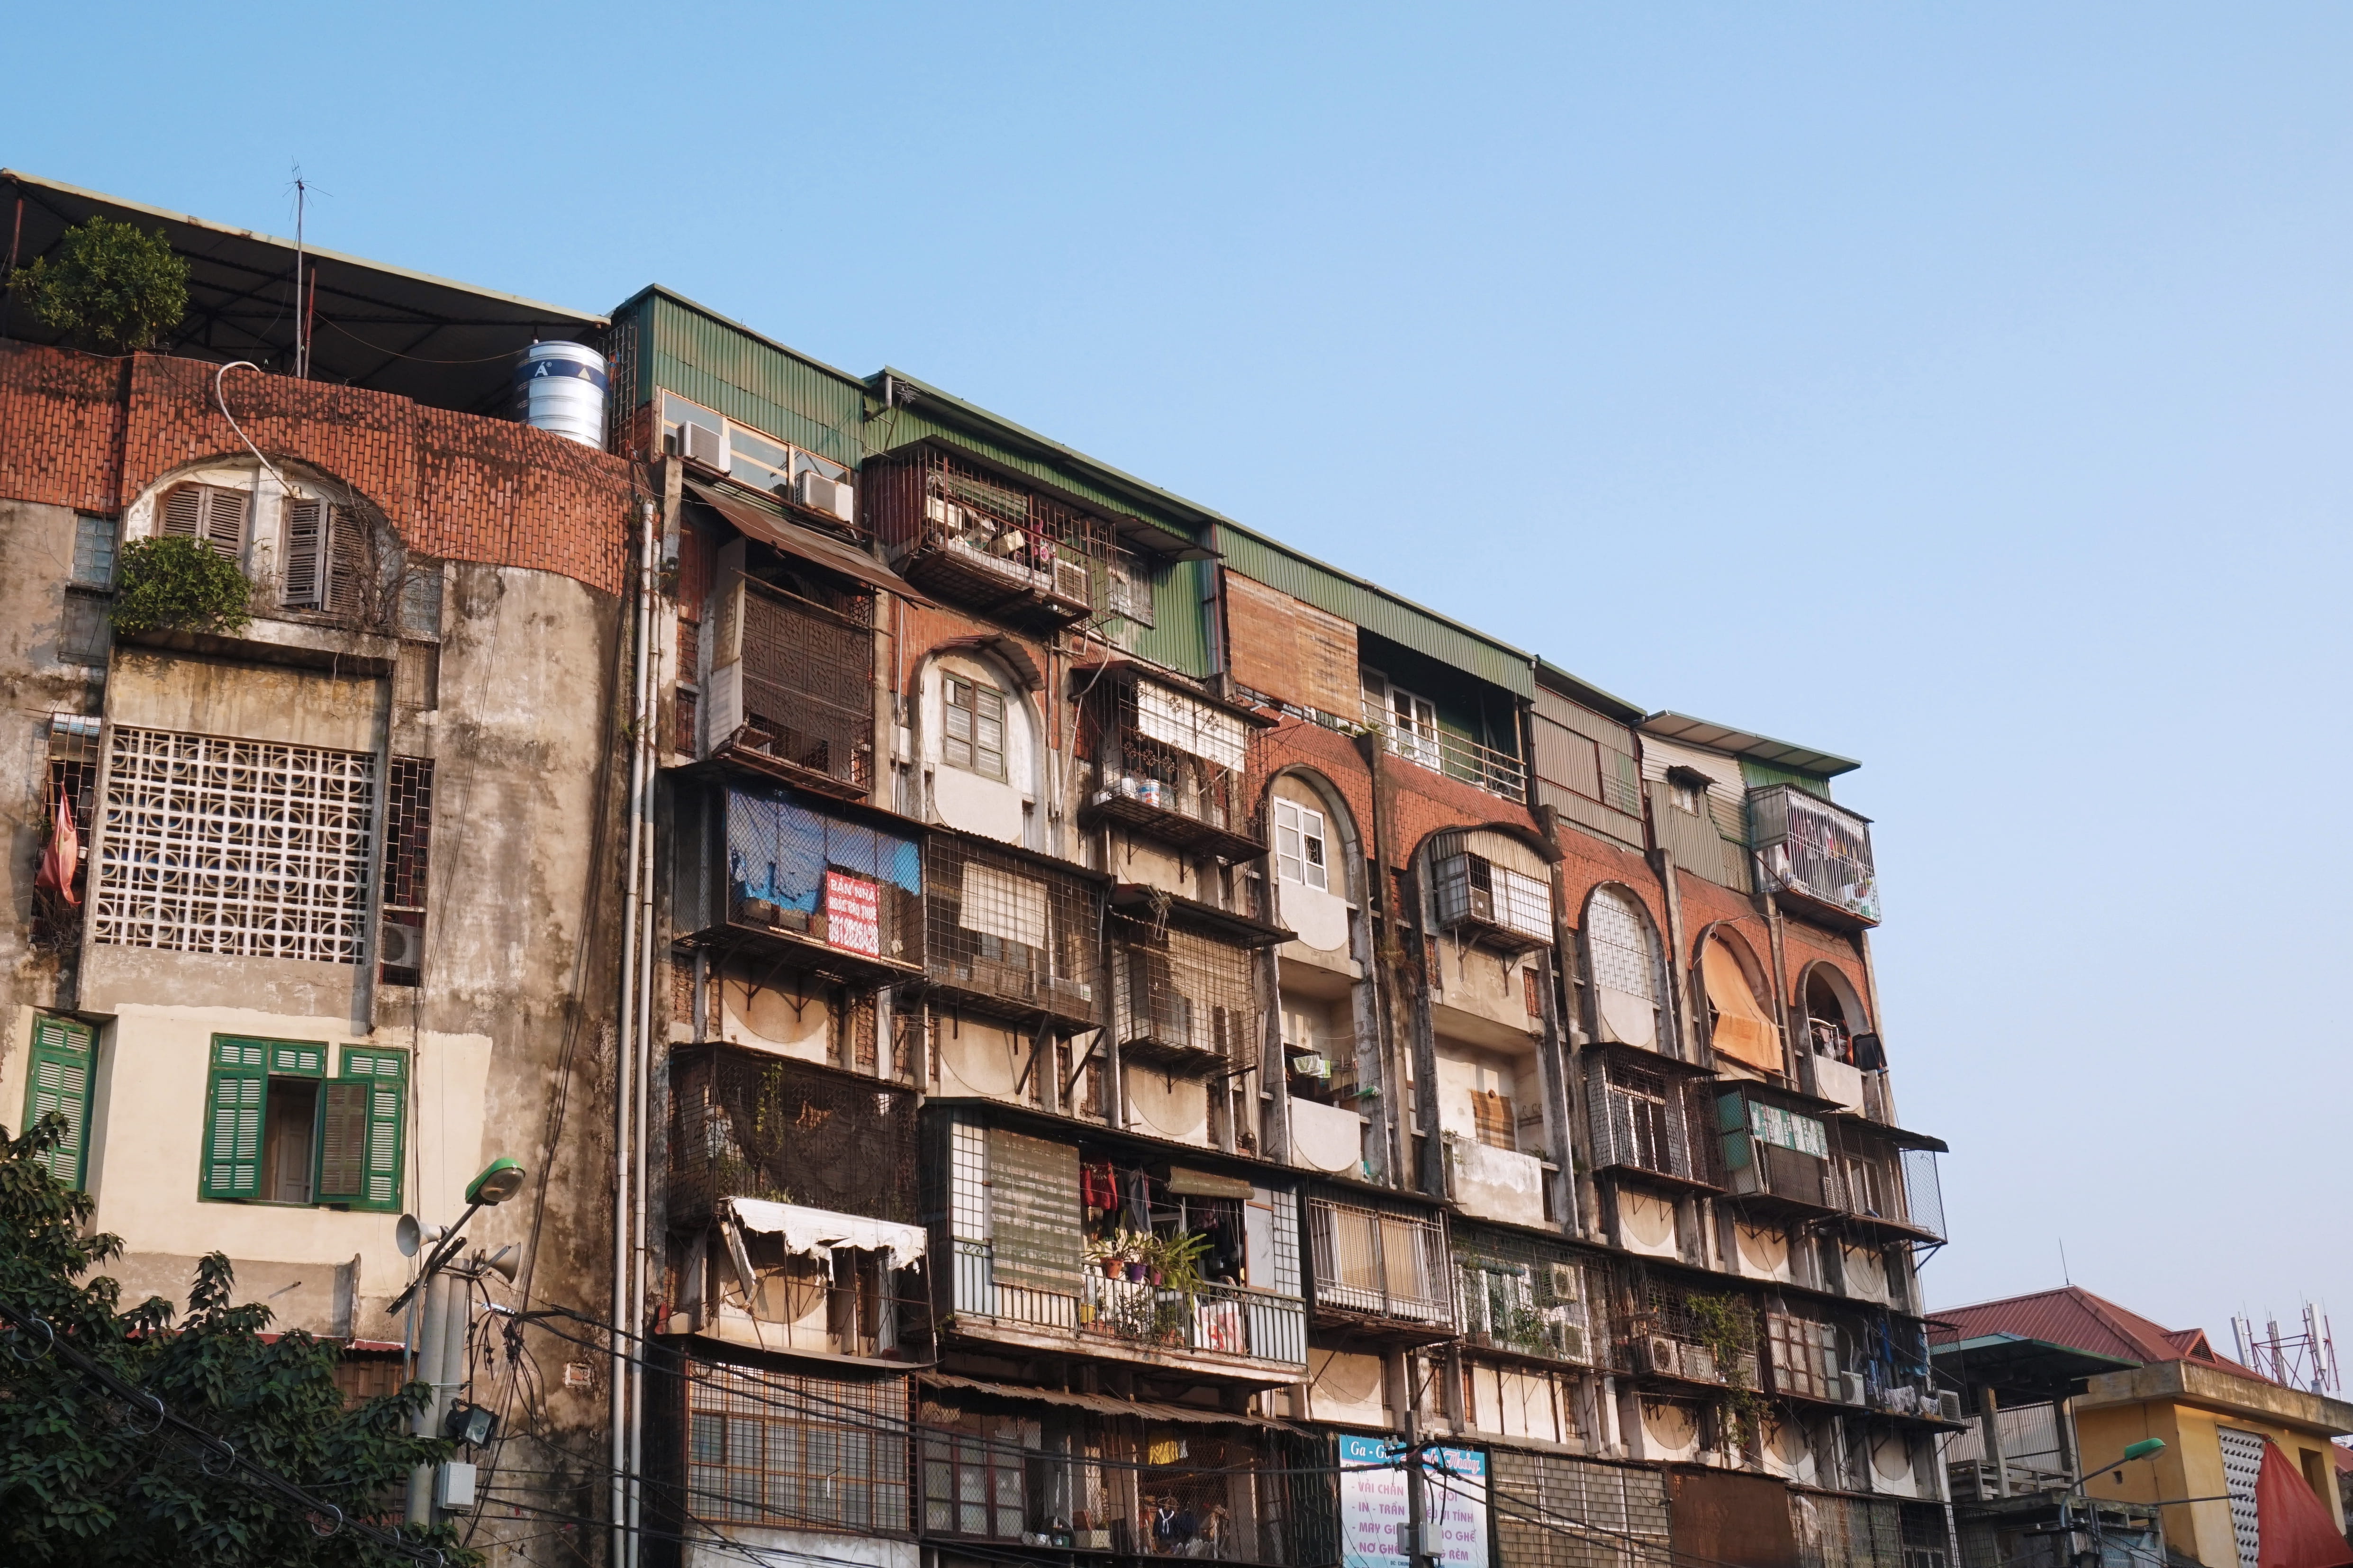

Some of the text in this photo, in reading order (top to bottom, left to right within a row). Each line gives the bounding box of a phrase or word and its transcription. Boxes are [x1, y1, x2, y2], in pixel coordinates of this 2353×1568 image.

[830, 878, 876, 902] BÁN NHÀ
[1350, 1441, 1366, 1457] Ga
[1358, 1478, 1374, 1493] VẢI
[1359, 1502, 1369, 1513] IN
[1379, 1501, 1405, 1516] TRẦN
[1452, 1509, 1473, 1523] TÍNH
[1359, 1522, 1380, 1533] MAY
[1359, 1541, 1376, 1553] NƠ
[1449, 1548, 1469, 1561] RÈM
